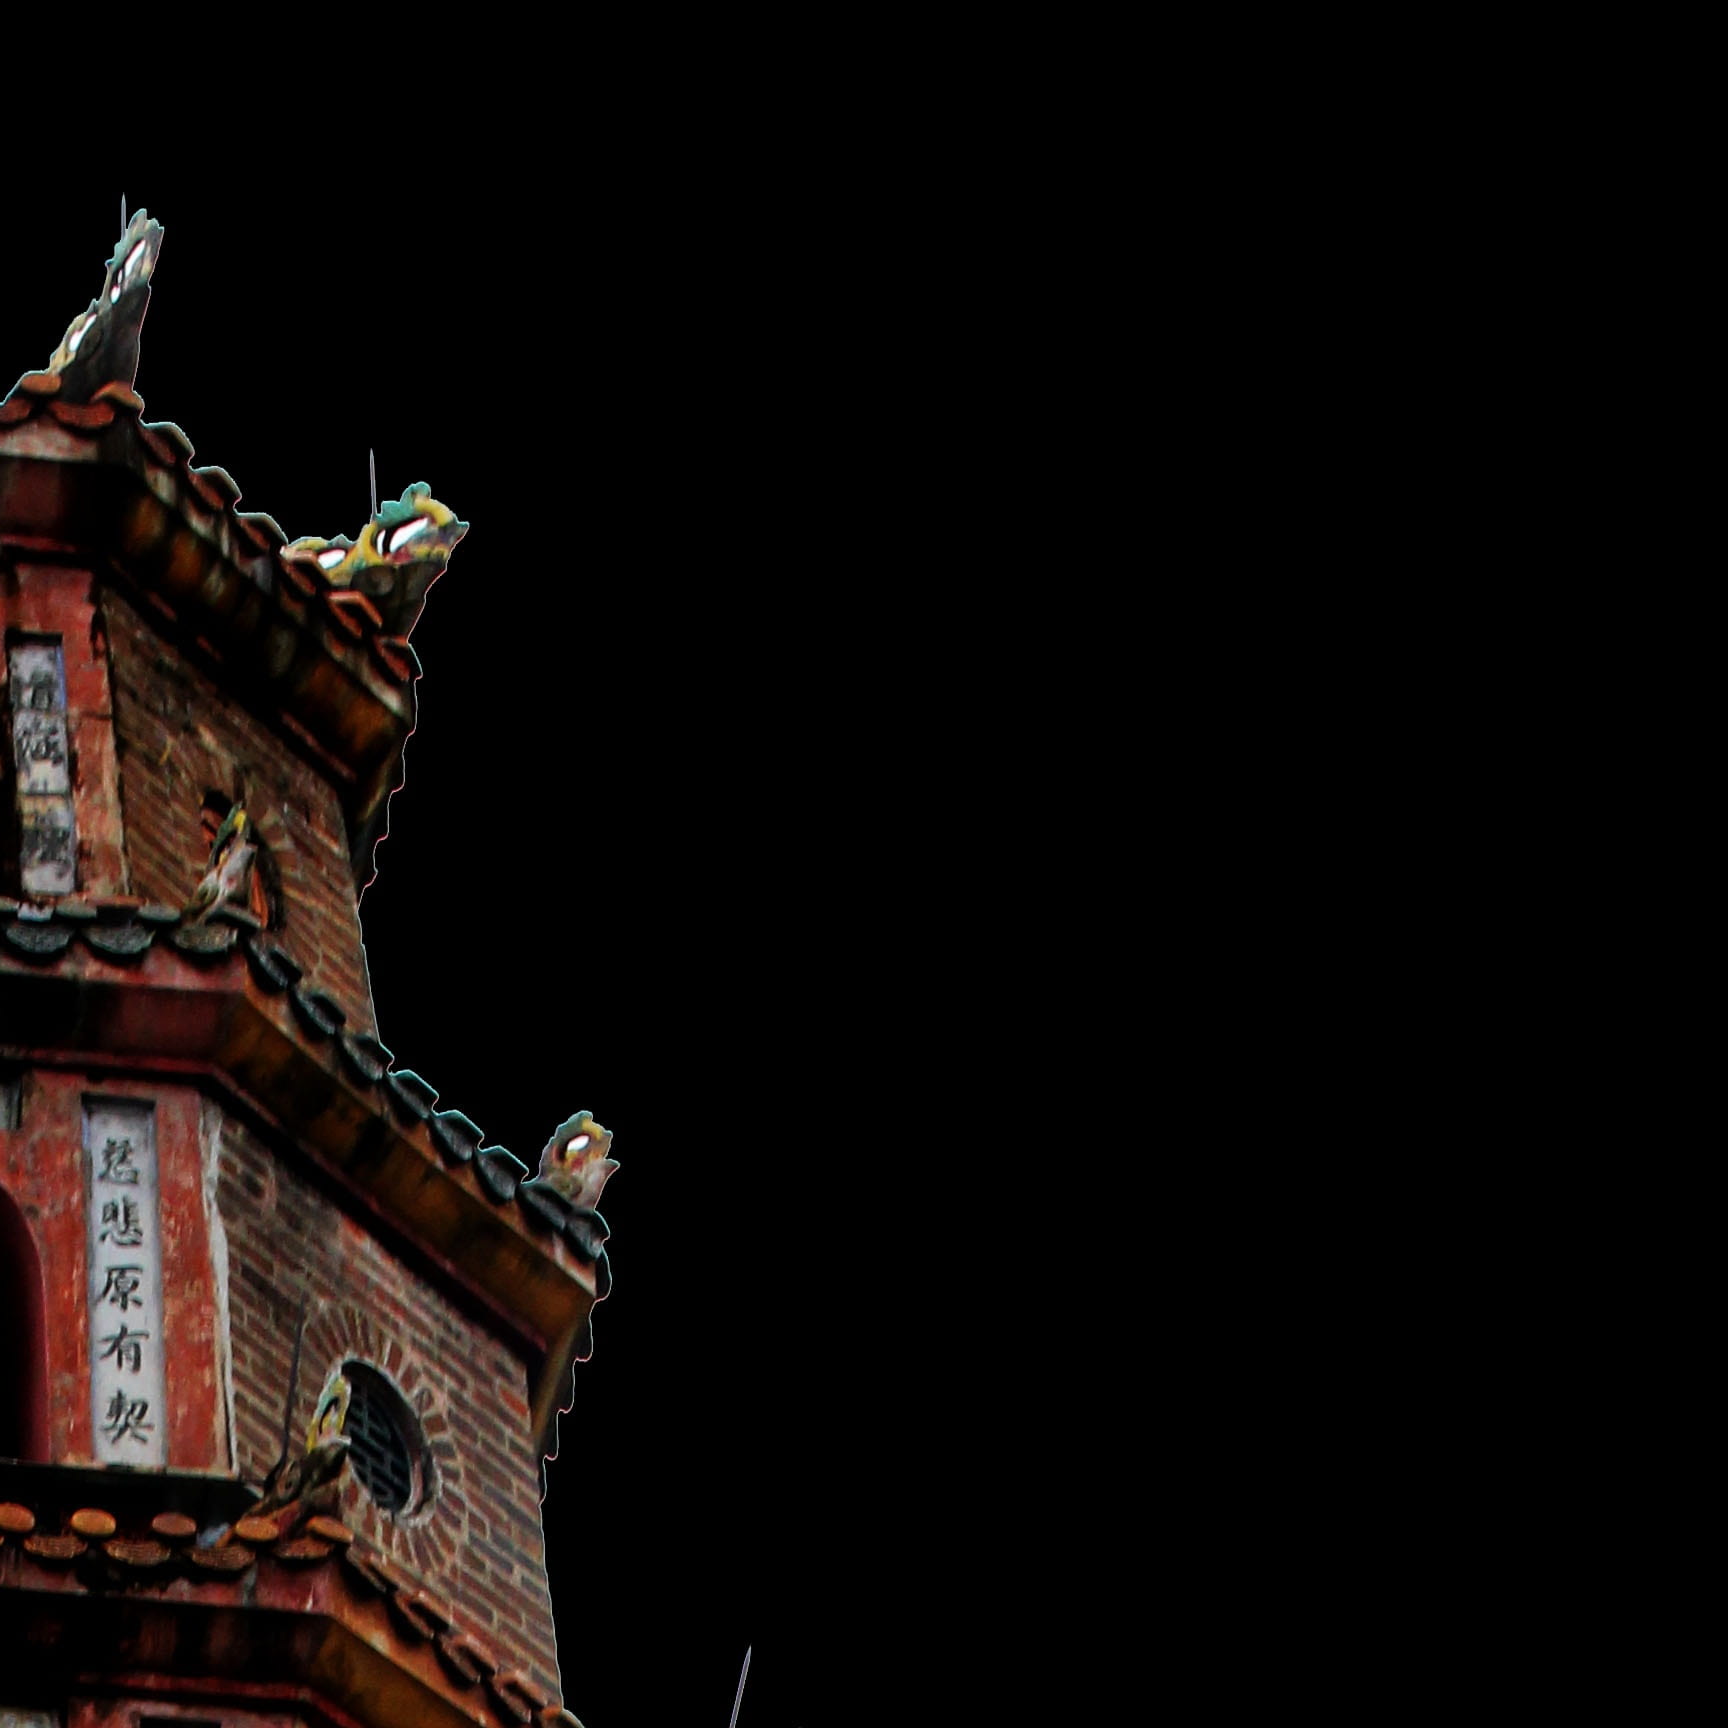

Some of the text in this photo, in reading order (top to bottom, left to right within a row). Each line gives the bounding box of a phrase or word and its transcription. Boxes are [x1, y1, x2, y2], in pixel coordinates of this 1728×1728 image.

[98, 1136, 154, 1444] 慈悲原有契
